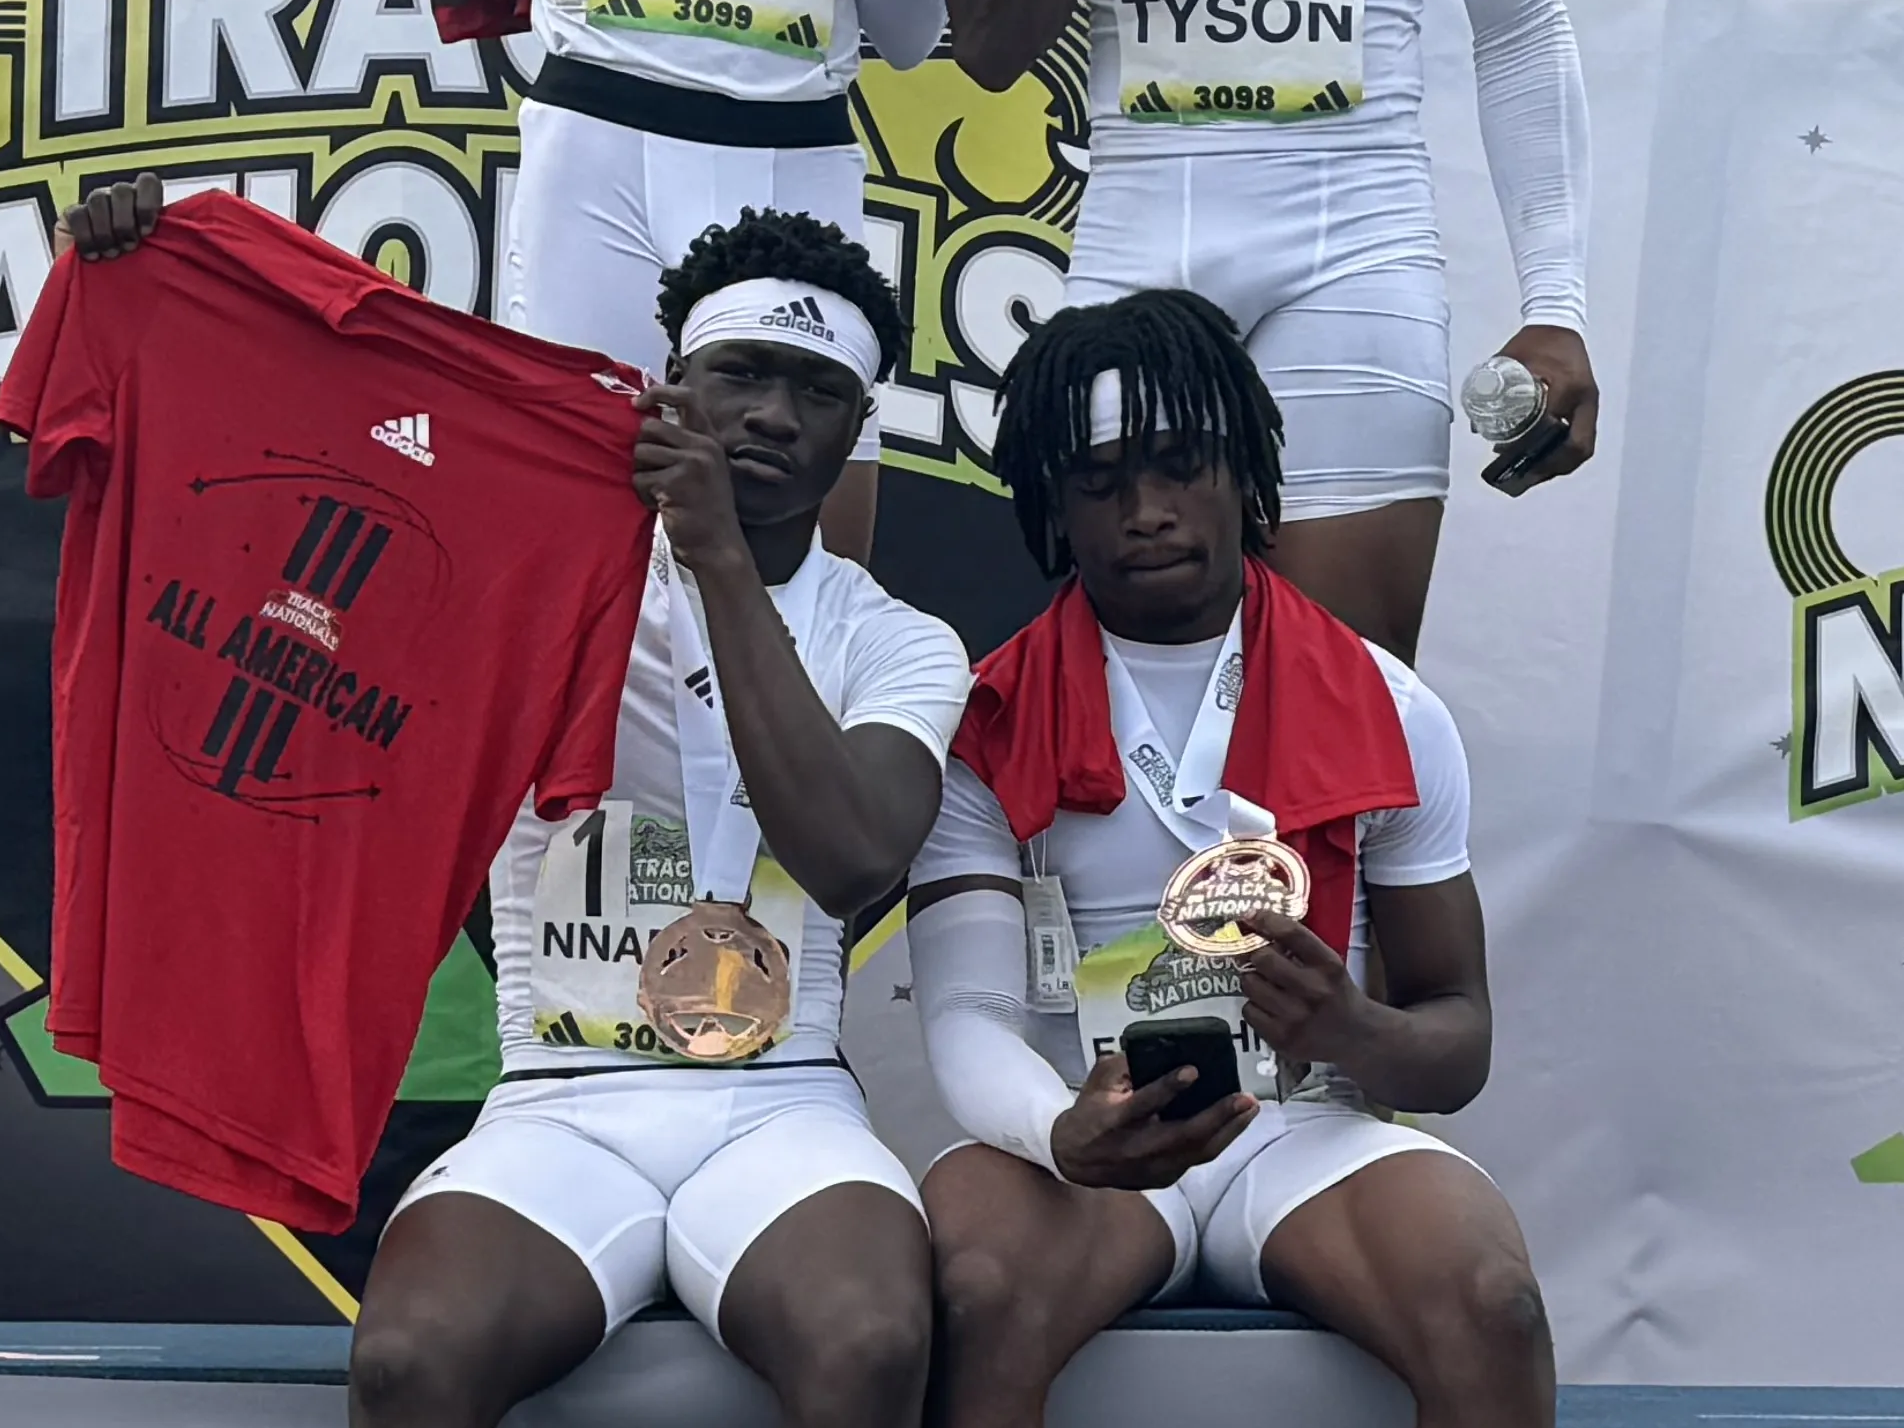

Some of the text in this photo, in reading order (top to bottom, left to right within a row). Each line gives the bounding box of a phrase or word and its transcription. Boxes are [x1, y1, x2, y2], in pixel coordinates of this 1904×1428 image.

[1193, 84, 1276, 112] 3098
[759, 314, 835, 343] adidas
[370, 424, 436, 467] adidas
[146, 578, 414, 752] ALL AMERICAN
[572, 808, 607, 917] 1
[634, 857, 691, 878] TRAC
[1205, 881, 1267, 900] TRACK
[1148, 974, 1243, 1012] NATIONA
